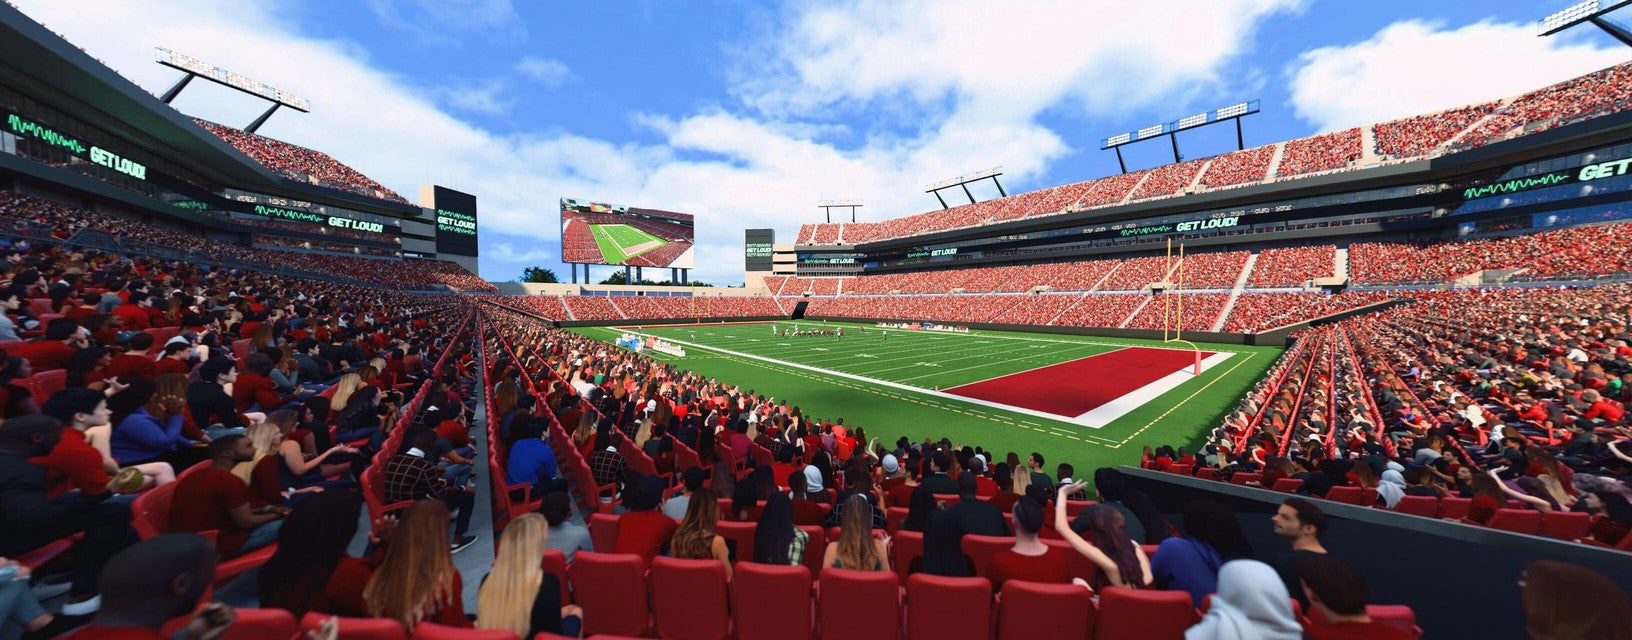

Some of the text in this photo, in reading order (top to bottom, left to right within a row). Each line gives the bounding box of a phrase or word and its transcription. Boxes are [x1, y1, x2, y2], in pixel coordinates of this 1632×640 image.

[90, 146, 147, 180] GET LOUD!
[1578, 157, 1632, 181] GET
[328, 216, 383, 233] GET LOUD!
[437, 216, 476, 230] GET LOUD!
[1176, 217, 1239, 232] GET LOUD!
